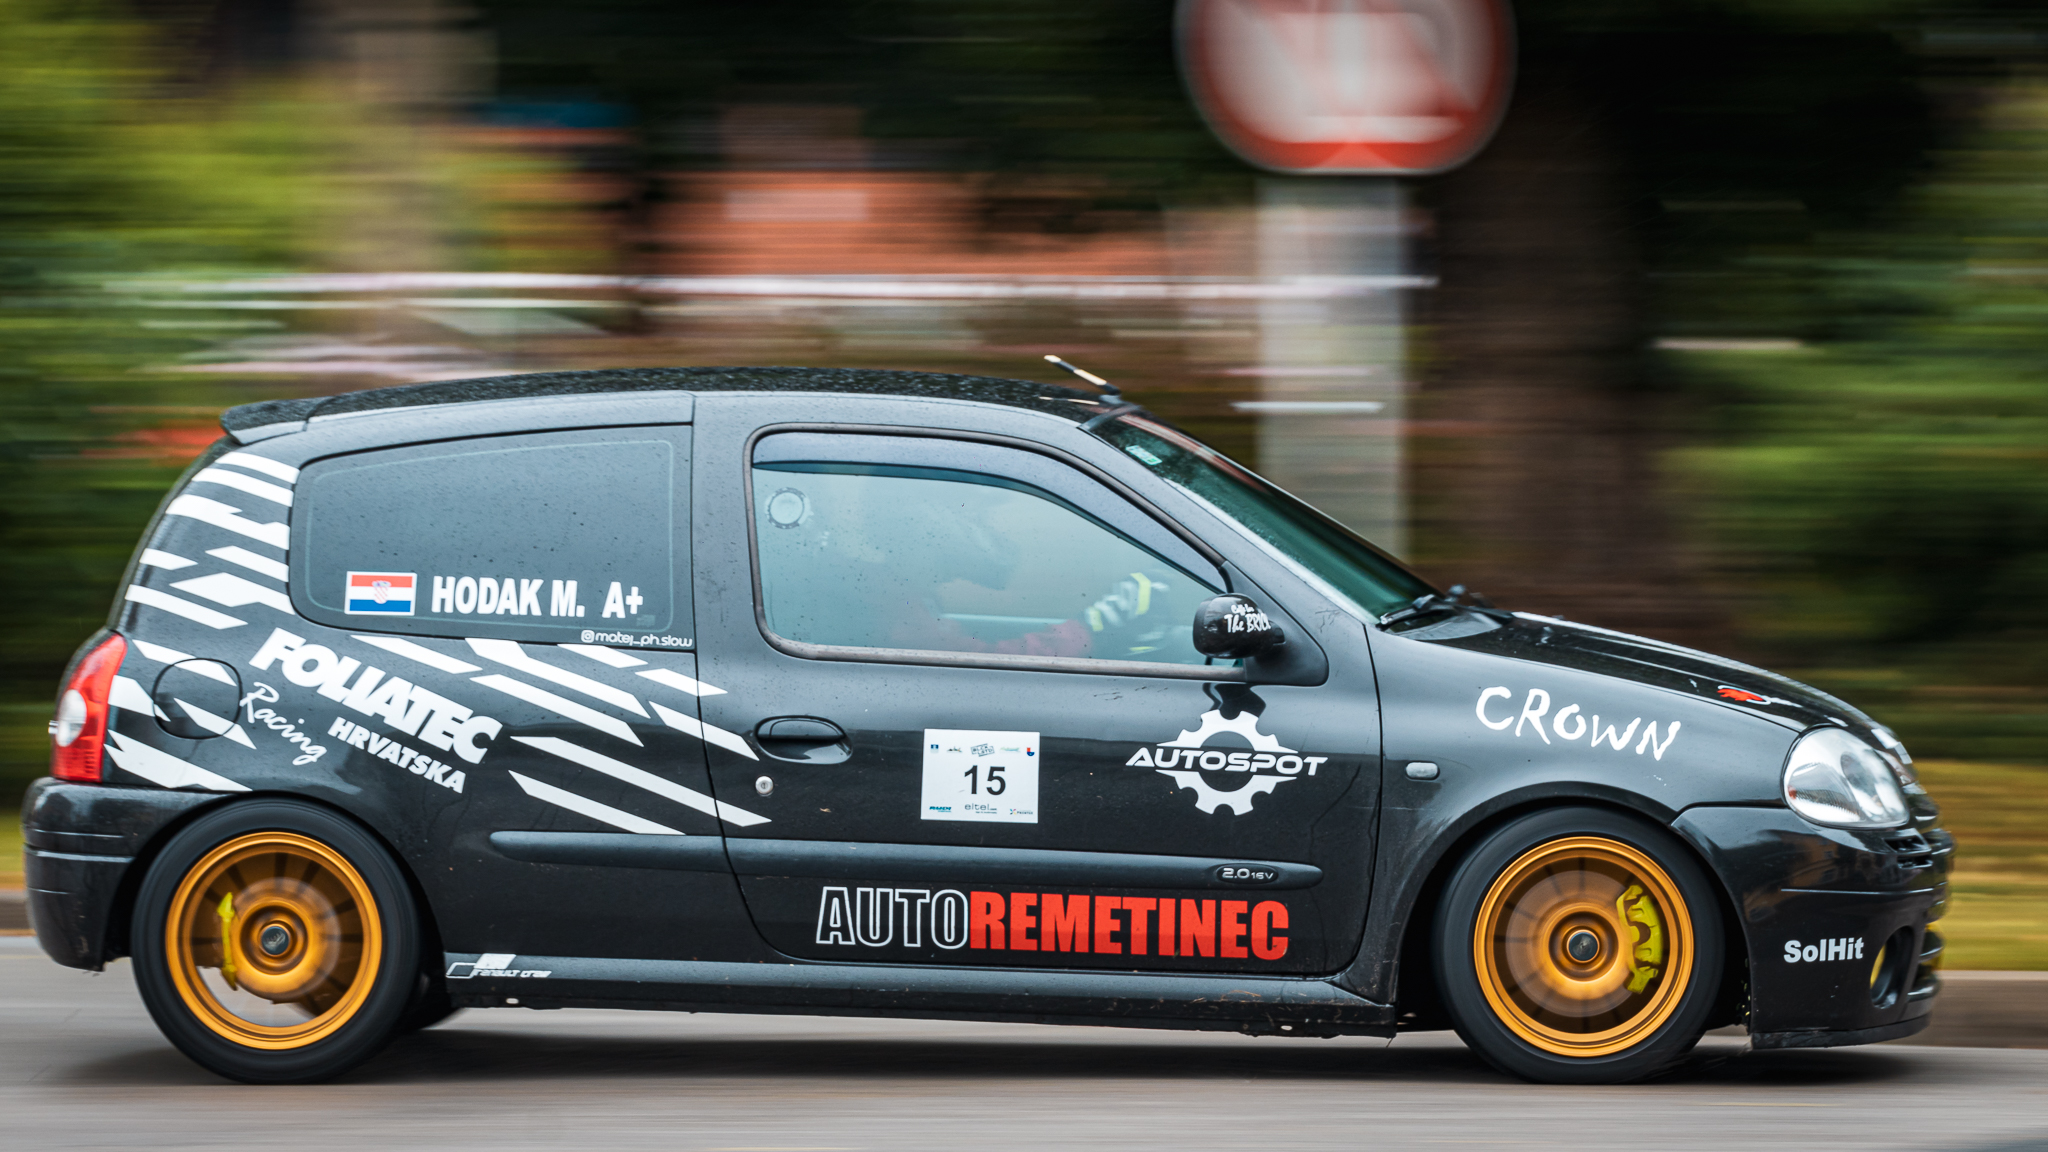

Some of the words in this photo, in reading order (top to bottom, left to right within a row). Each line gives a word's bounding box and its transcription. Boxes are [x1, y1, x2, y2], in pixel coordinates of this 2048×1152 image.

[431, 575, 544, 617] HODAK
[549, 579, 586, 618] M.
[601, 581, 644, 619] A+
[248, 626, 503, 765] FOLIATEC
[239, 681, 328, 766] Racing
[1475, 685, 1681, 761] CROWN
[327, 716, 467, 794] HRVATSKA
[1125, 746, 1328, 777] AUTOSPOT
[964, 764, 1006, 796] 15
[1222, 867, 1250, 879] 2.0
[1251, 872, 1274, 880] 16V
[1783, 937, 1864, 964] SolHit
